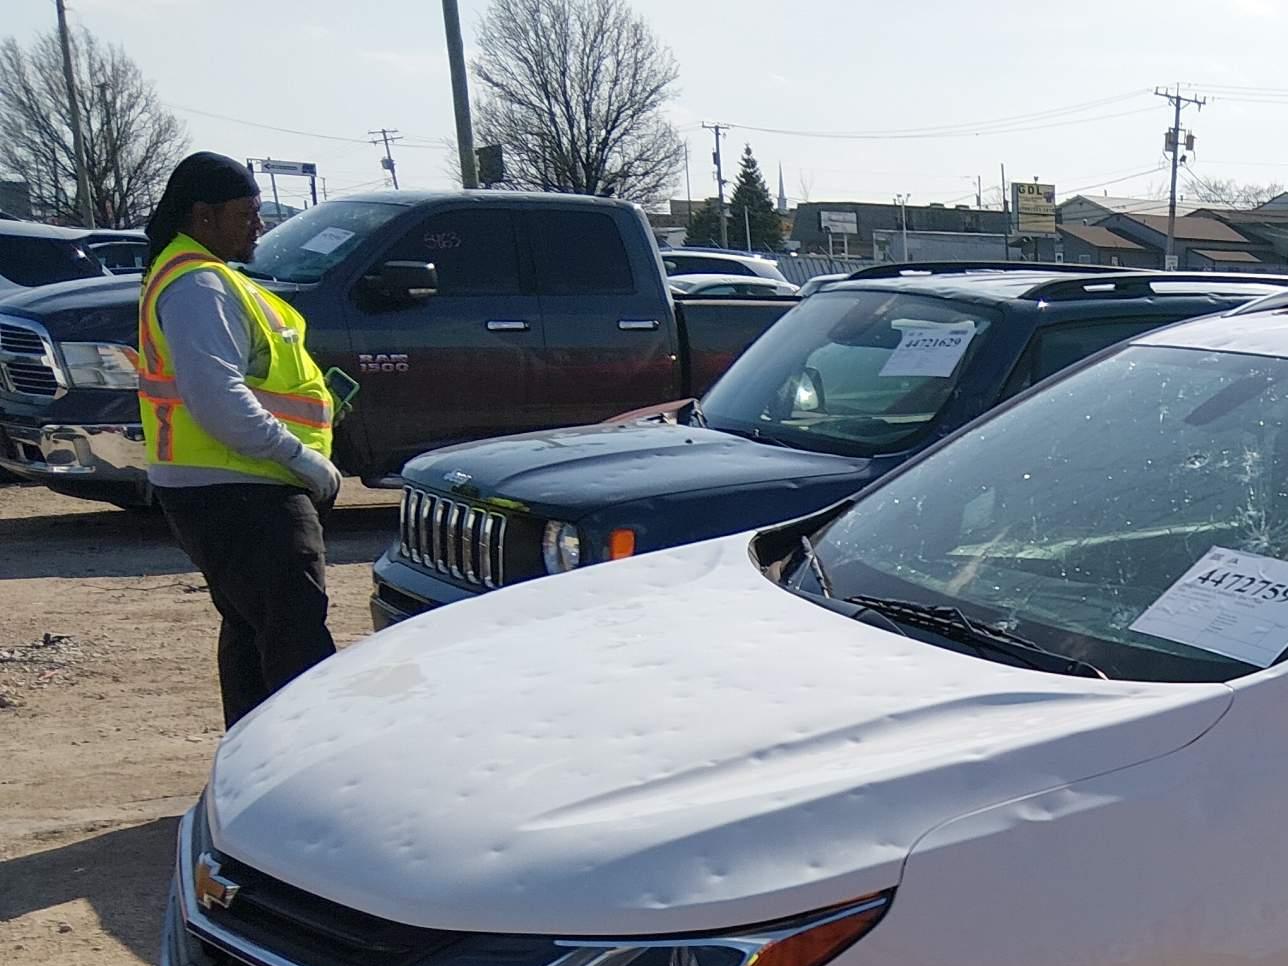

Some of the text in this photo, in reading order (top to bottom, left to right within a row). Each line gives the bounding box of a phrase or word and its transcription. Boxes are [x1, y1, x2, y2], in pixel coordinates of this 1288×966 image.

[904, 337, 962, 348] 44721629
[359, 353, 408, 363] RAM
[359, 363, 409, 372] 1500
